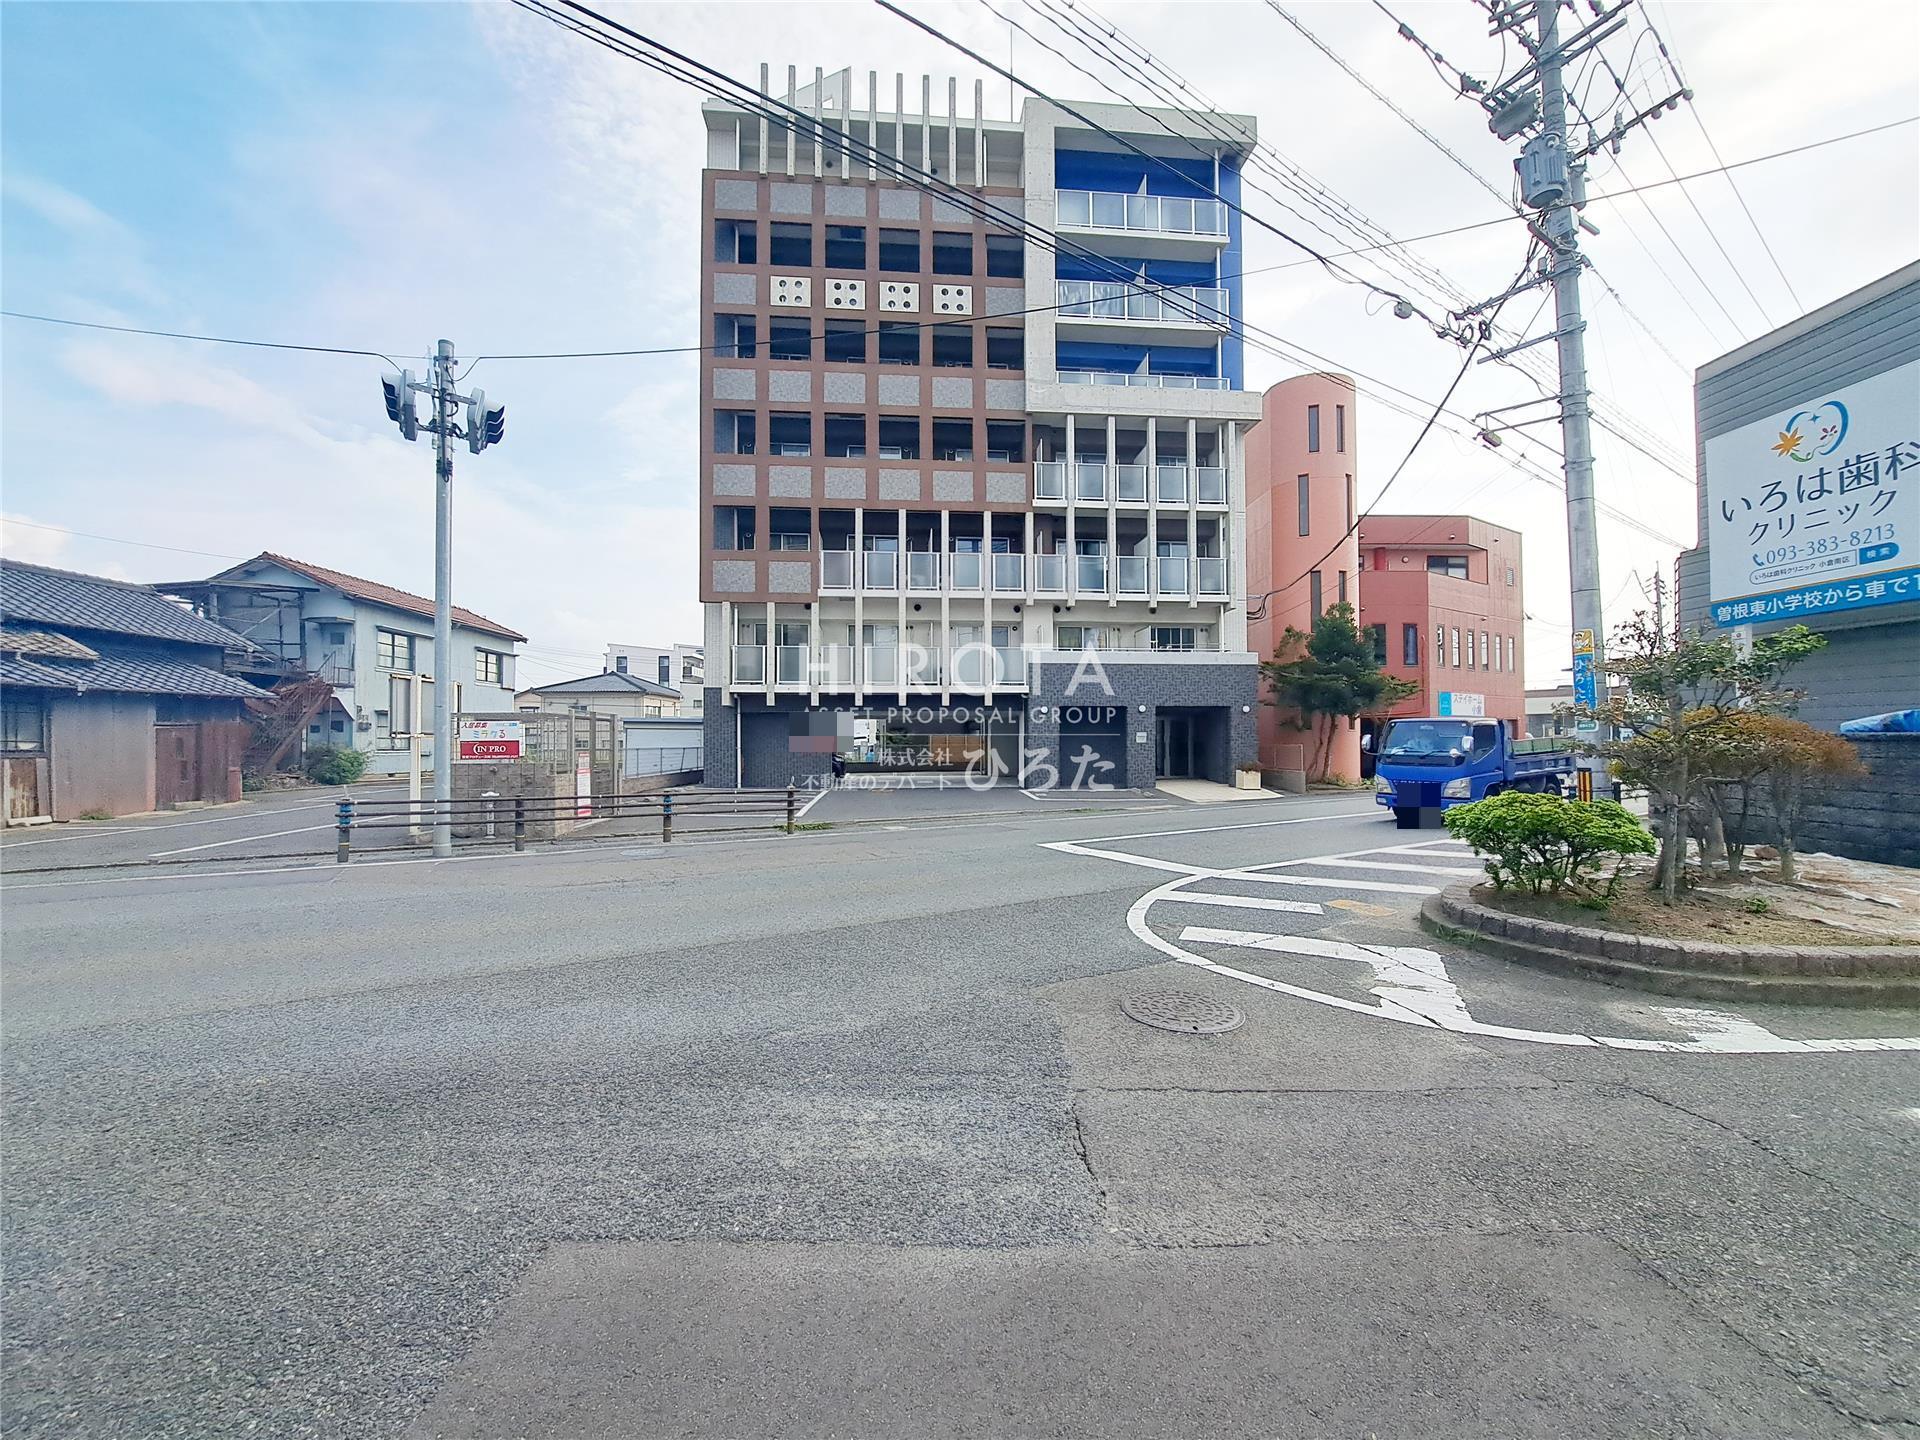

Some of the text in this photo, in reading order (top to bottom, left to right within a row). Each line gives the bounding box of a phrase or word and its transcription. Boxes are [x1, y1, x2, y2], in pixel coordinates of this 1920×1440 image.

[1722, 441, 1920, 522] いろは歯科
[1749, 489, 1897, 546] クリニック
[1766, 523, 1895, 564] 093-383-8213
[1754, 563, 1816, 580] いろは歯科クリニック
[489, 745, 507, 753] PRO
